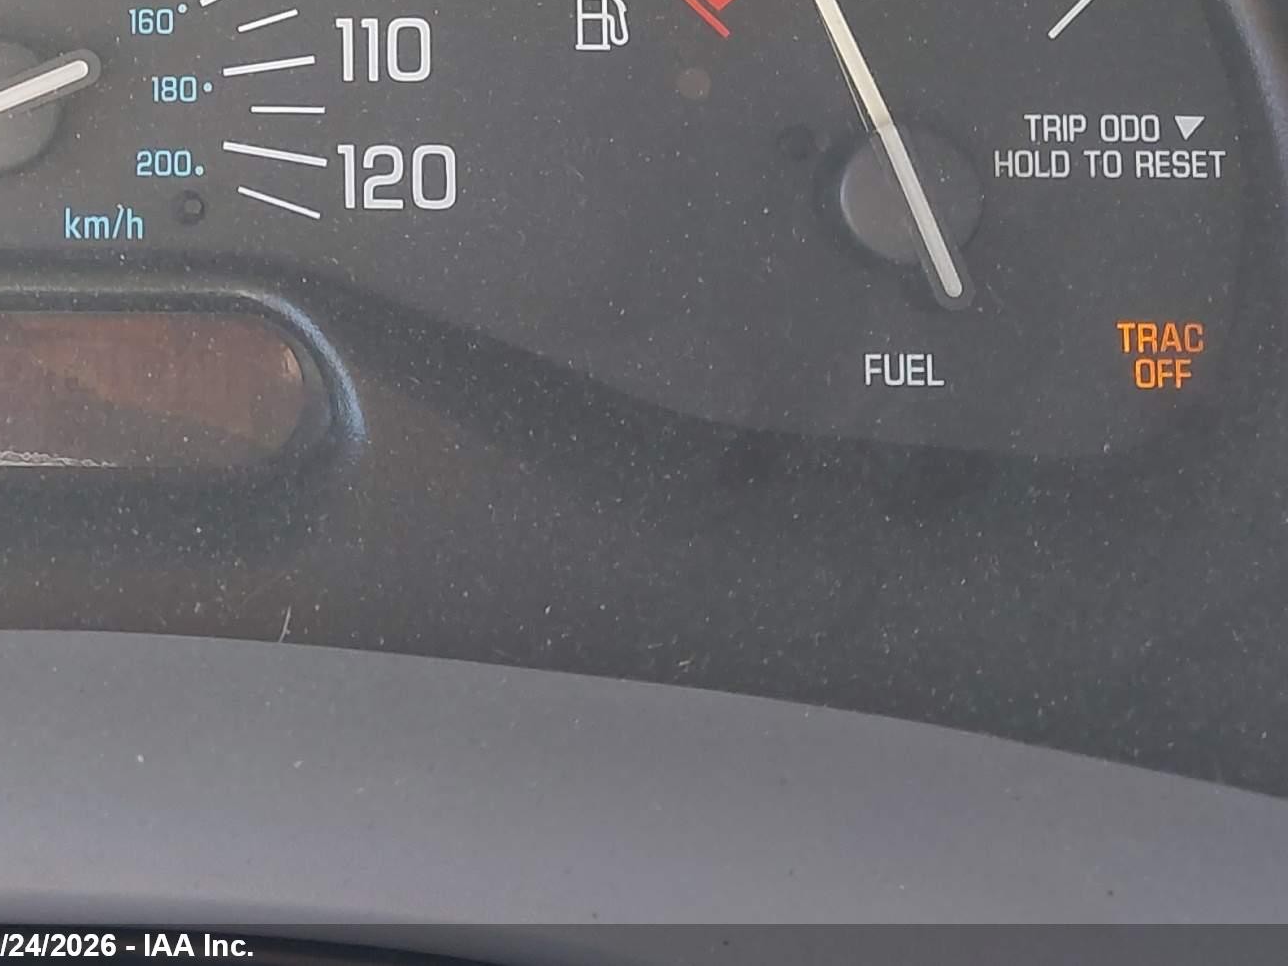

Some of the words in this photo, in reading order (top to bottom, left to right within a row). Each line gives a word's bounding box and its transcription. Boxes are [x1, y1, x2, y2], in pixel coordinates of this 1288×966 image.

[128, 8, 174, 35] 160
[335, 17, 431, 82] 110
[151, 76, 197, 102] 180
[1023, 114, 1087, 142] TRIP
[1100, 114, 1160, 142] ODO
[136, 150, 192, 177] 200
[337, 144, 456, 210] 120
[994, 149, 1070, 178] HOLD
[1083, 150, 1122, 178] TO
[1135, 150, 1226, 179] RESET
[65, 204, 143, 239] km/h
[1116, 322, 1204, 353] TRAC
[865, 353, 945, 386] FUEL
[1135, 358, 1192, 389] OFF
